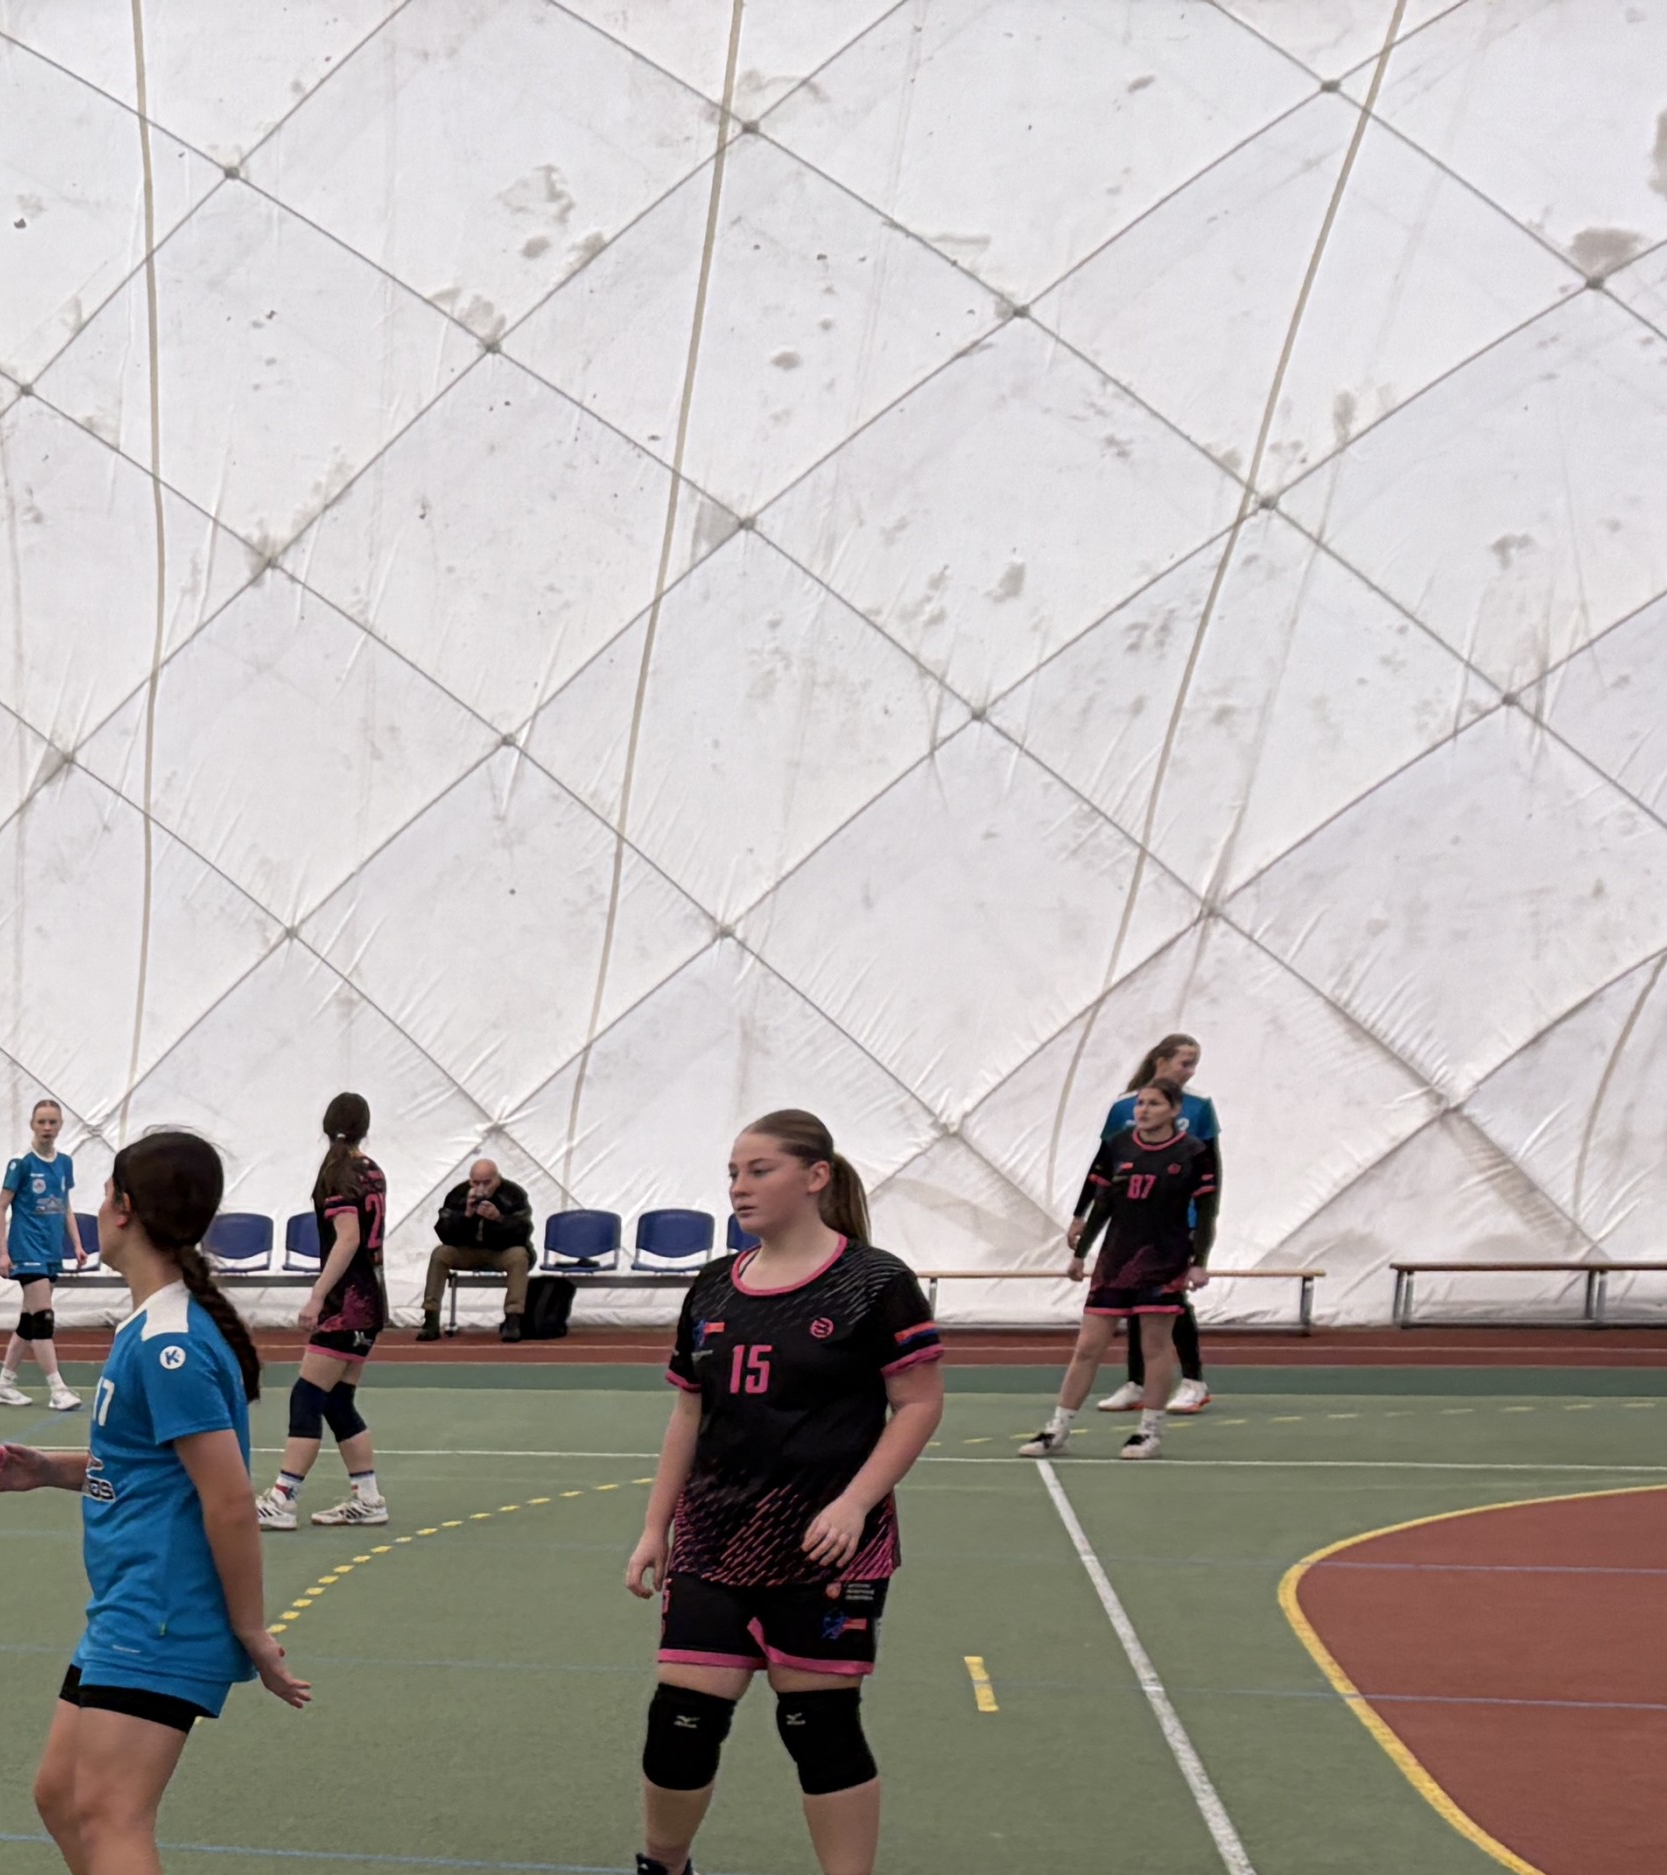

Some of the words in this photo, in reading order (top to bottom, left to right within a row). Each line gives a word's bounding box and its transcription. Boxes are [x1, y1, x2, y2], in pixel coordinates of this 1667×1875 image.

[1127, 1174, 1157, 1199] 87
[730, 1344, 773, 1395] 15
[92, 1375, 115, 1427] 17
